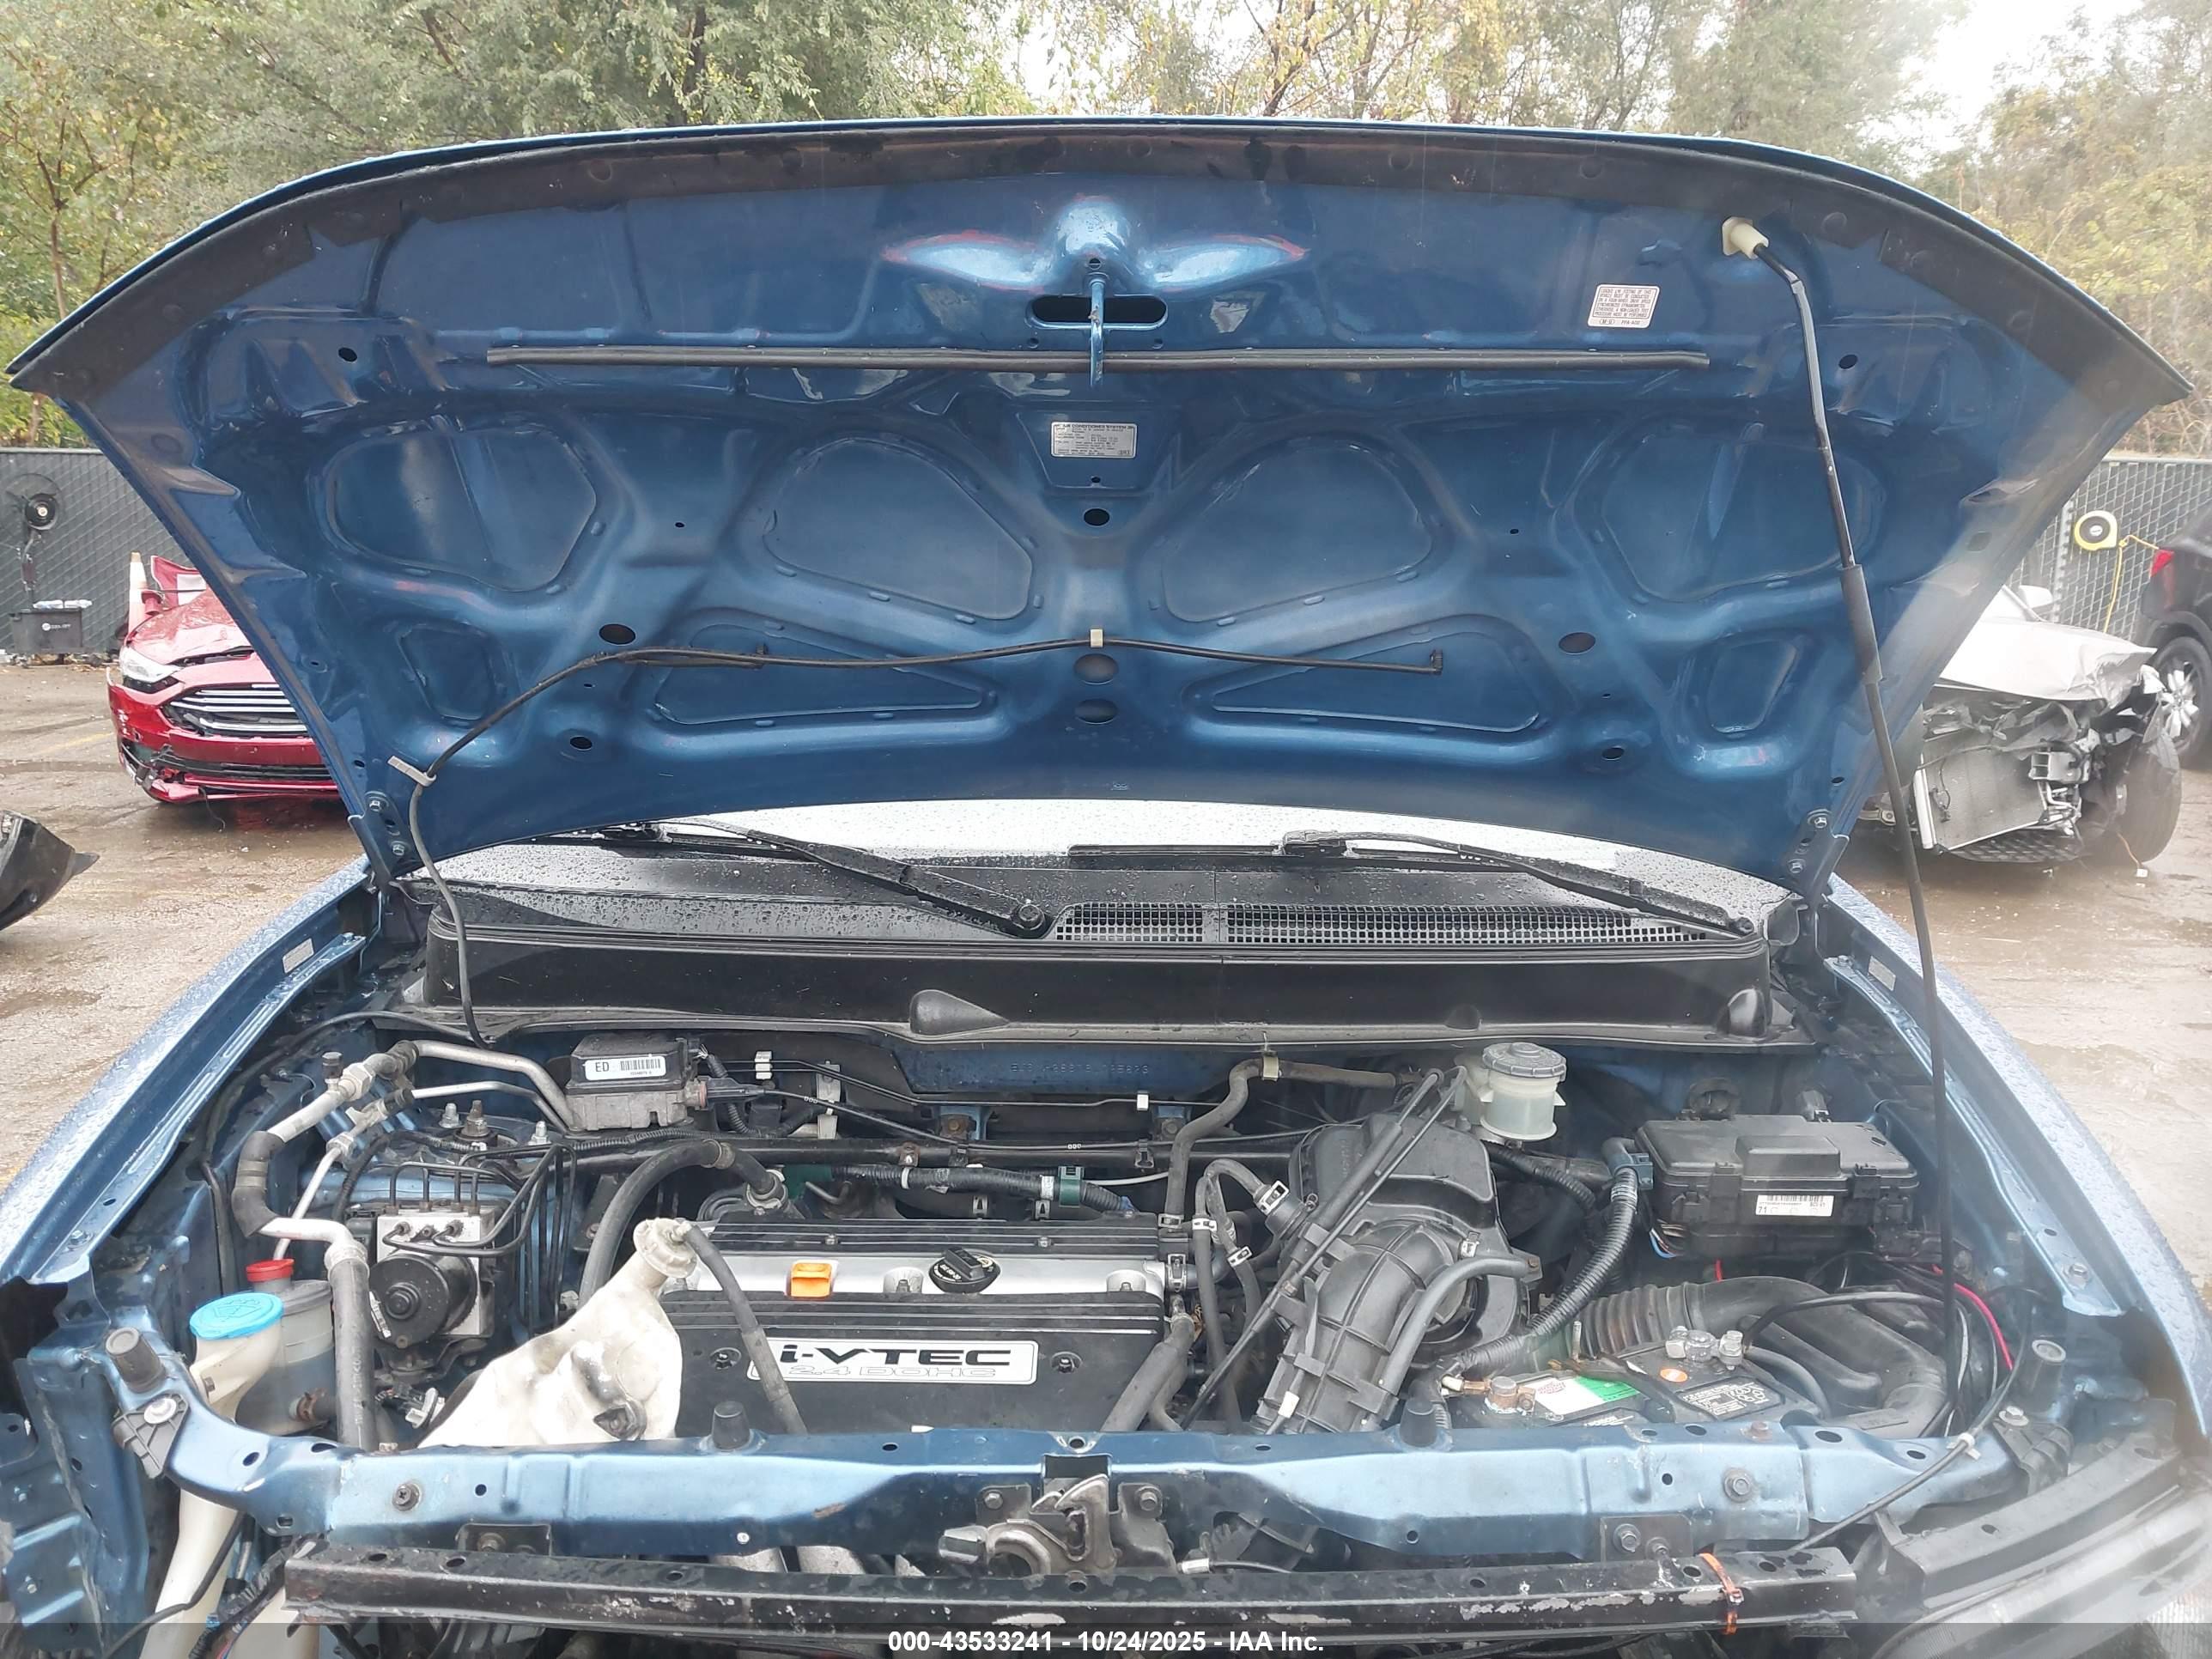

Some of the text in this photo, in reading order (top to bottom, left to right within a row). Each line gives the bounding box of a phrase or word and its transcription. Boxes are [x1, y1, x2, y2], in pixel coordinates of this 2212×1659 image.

[595, 1061, 610, 1073] ED
[780, 1344, 1012, 1366] i-VTEC
[788, 1364, 996, 1377] 2.4 DOHC
